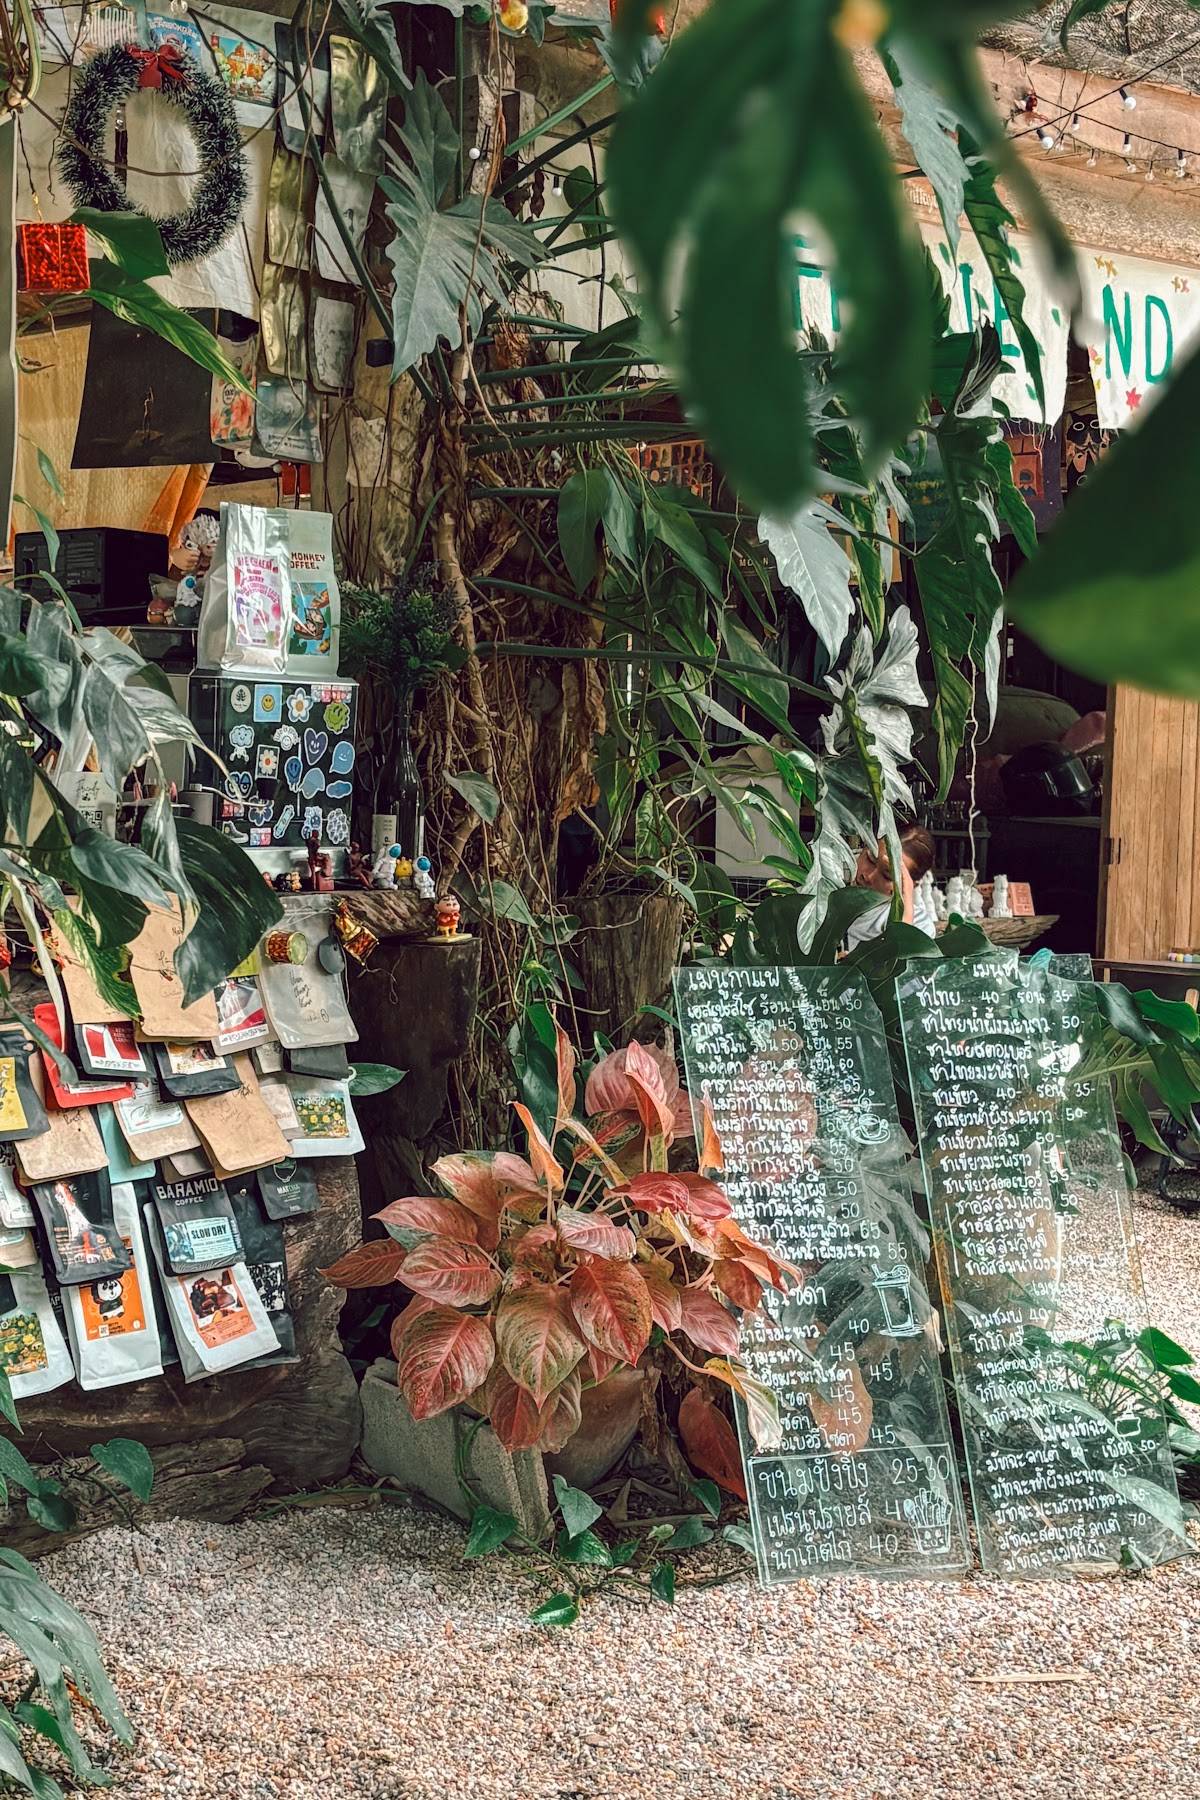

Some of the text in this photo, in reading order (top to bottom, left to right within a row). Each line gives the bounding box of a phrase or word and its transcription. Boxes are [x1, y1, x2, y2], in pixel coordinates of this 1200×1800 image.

[290, 560, 320, 570] OFFEE.
[291, 552, 326, 562] MONKEY
[972, 957, 1019, 985] เมนูชา
[688, 966, 780, 1000] เมนูกาแฟ
[915, 972, 962, 1008] ชาไทย
[759, 993, 792, 1016] ร้อน
[845, 999, 862, 1012] 50
[778, 1017, 797, 1033] 45
[835, 1017, 851, 1030] 50
[781, 1038, 799, 1052] 50
[837, 1037, 853, 1050] 55
[839, 1058, 854, 1072] 60
[843, 1077, 861, 1093] 65
[932, 1083, 980, 1108] ชาเขียว
[713, 1112, 808, 1133] เมริกาโน่กลาง
[829, 1139, 848, 1157] 55
[833, 1157, 854, 1173] 50
[156, 1178, 219, 1200] BARAMIO
[837, 1181, 857, 1196] 50
[841, 1201, 860, 1218] 50
[191, 1227, 211, 1240] SLOW
[859, 1221, 881, 1240] 65
[888, 1243, 908, 1260] 55
[848, 1318, 870, 1335] 40
[969, 1329, 1006, 1354] โกโก้
[829, 1342, 855, 1362] 45
[869, 1362, 893, 1381] 45
[775, 1385, 855, 1407] โซดา 45
[838, 1407, 862, 1426] 45
[871, 1424, 897, 1444] 45
[758, 1450, 950, 1499] ขนมปังปิ้ง 25-30
[766, 1491, 872, 1538] เฟรนฟรายส์
[770, 1529, 899, 1570] นักเก็ตไก่ 40
